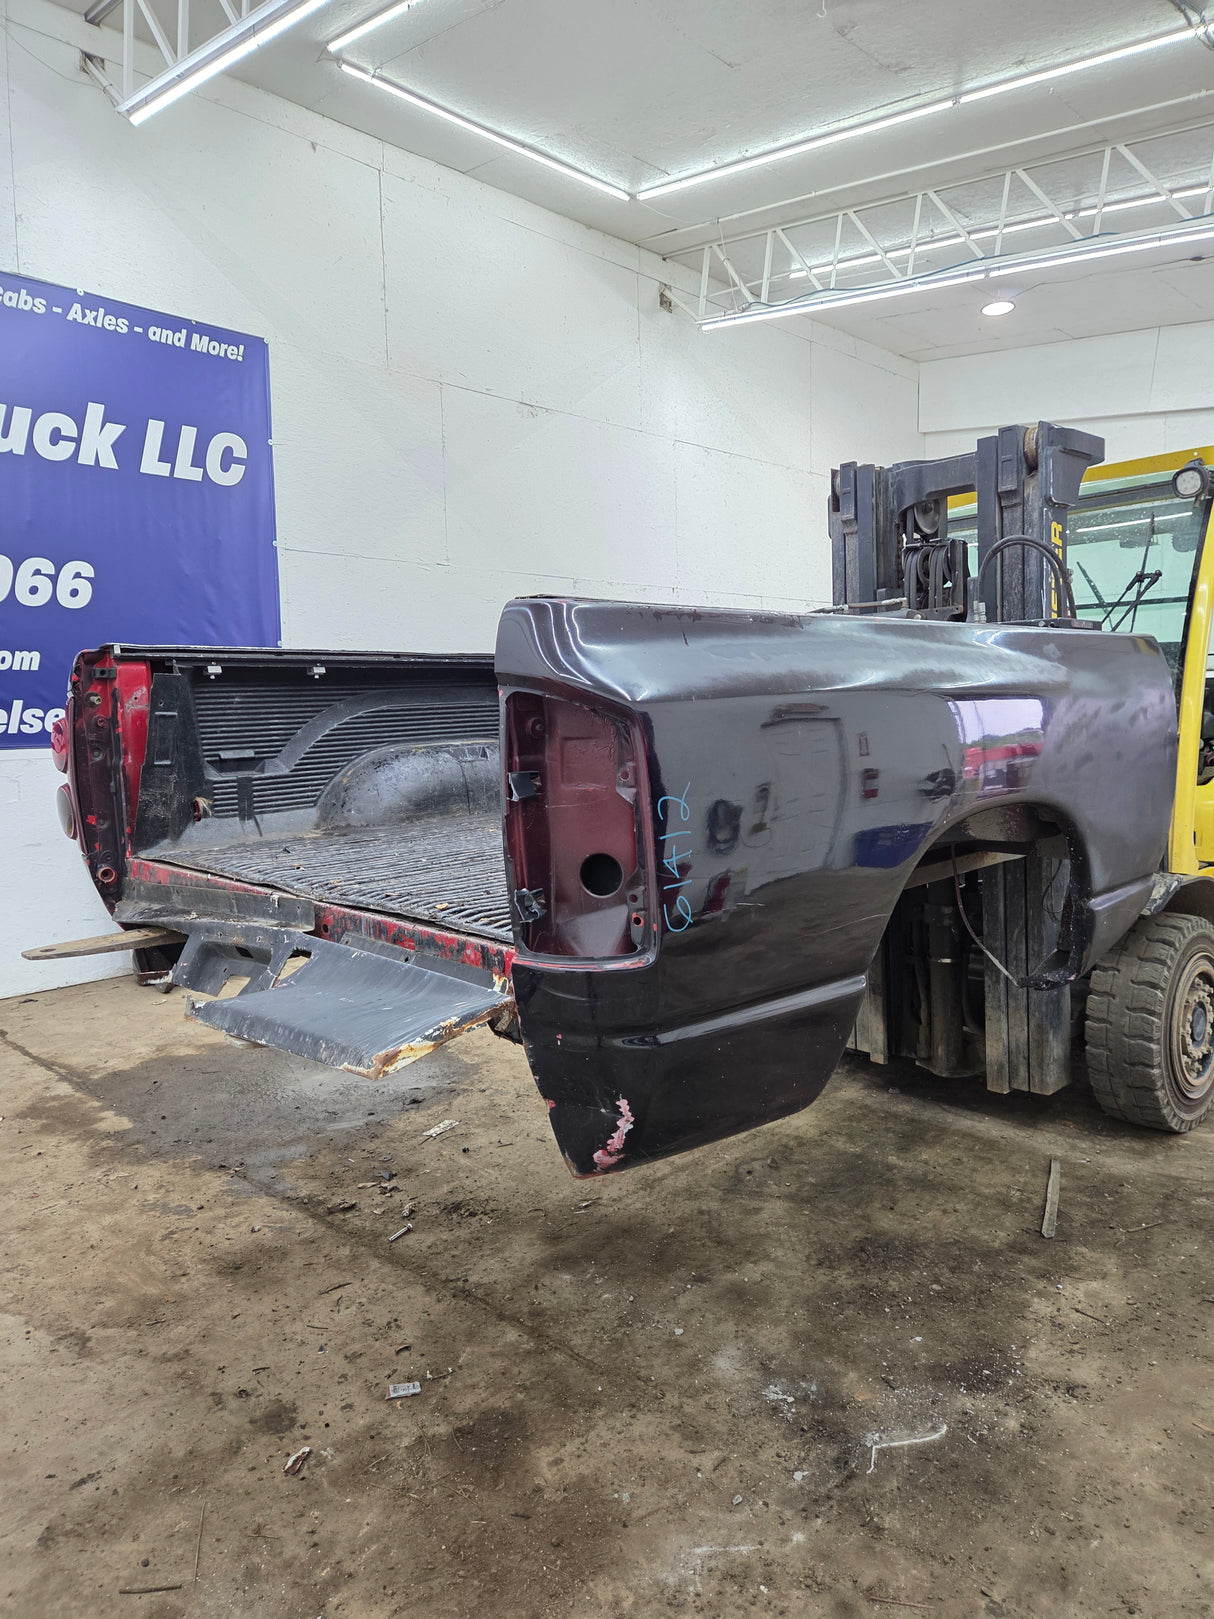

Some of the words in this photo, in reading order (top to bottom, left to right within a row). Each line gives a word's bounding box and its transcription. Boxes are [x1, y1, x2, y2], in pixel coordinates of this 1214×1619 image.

[0, 286, 47, 314] abs
[66, 302, 129, 334] Axles
[148, 323, 187, 348] and
[190, 333, 244, 361] More!
[140, 419, 248, 486] LLC
